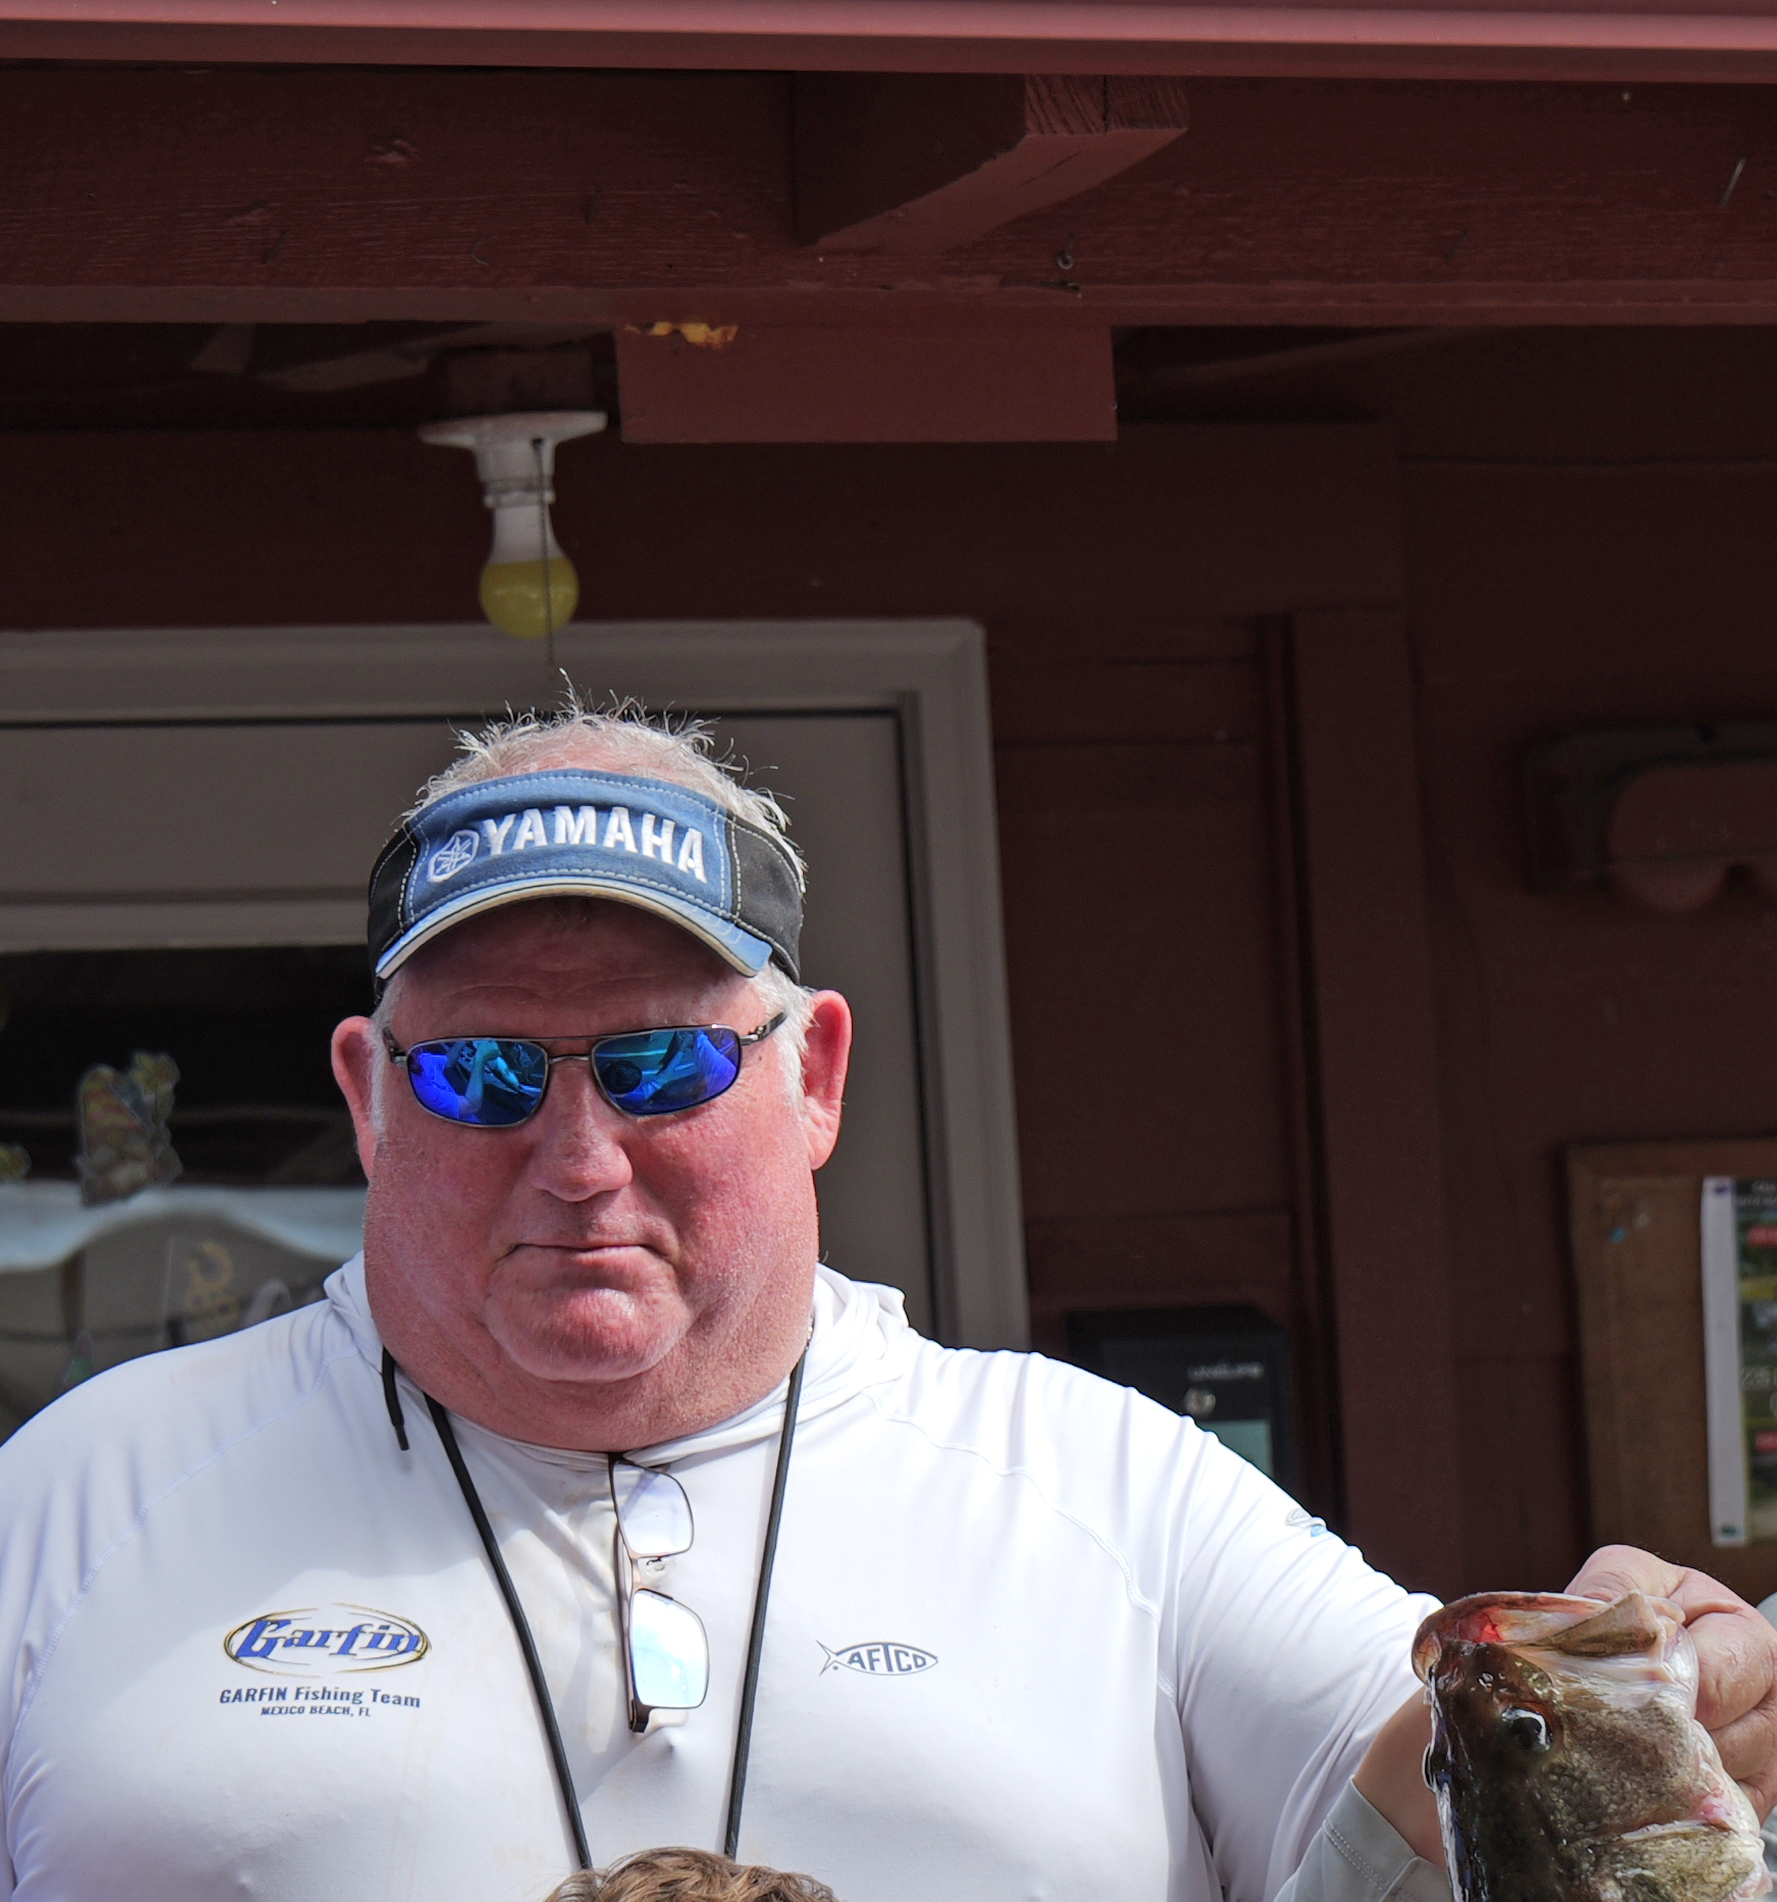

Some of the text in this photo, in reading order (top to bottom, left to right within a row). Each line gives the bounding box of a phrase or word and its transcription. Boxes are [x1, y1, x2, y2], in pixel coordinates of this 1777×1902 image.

[482, 805, 708, 884] YAMAHA
[235, 1618, 422, 1658] Garfin
[847, 1643, 927, 1672] AFTCO
[219, 1686, 421, 1708] GARFIN Fishing Team
[260, 1706, 372, 1718] MEXICO BEACH, FL
